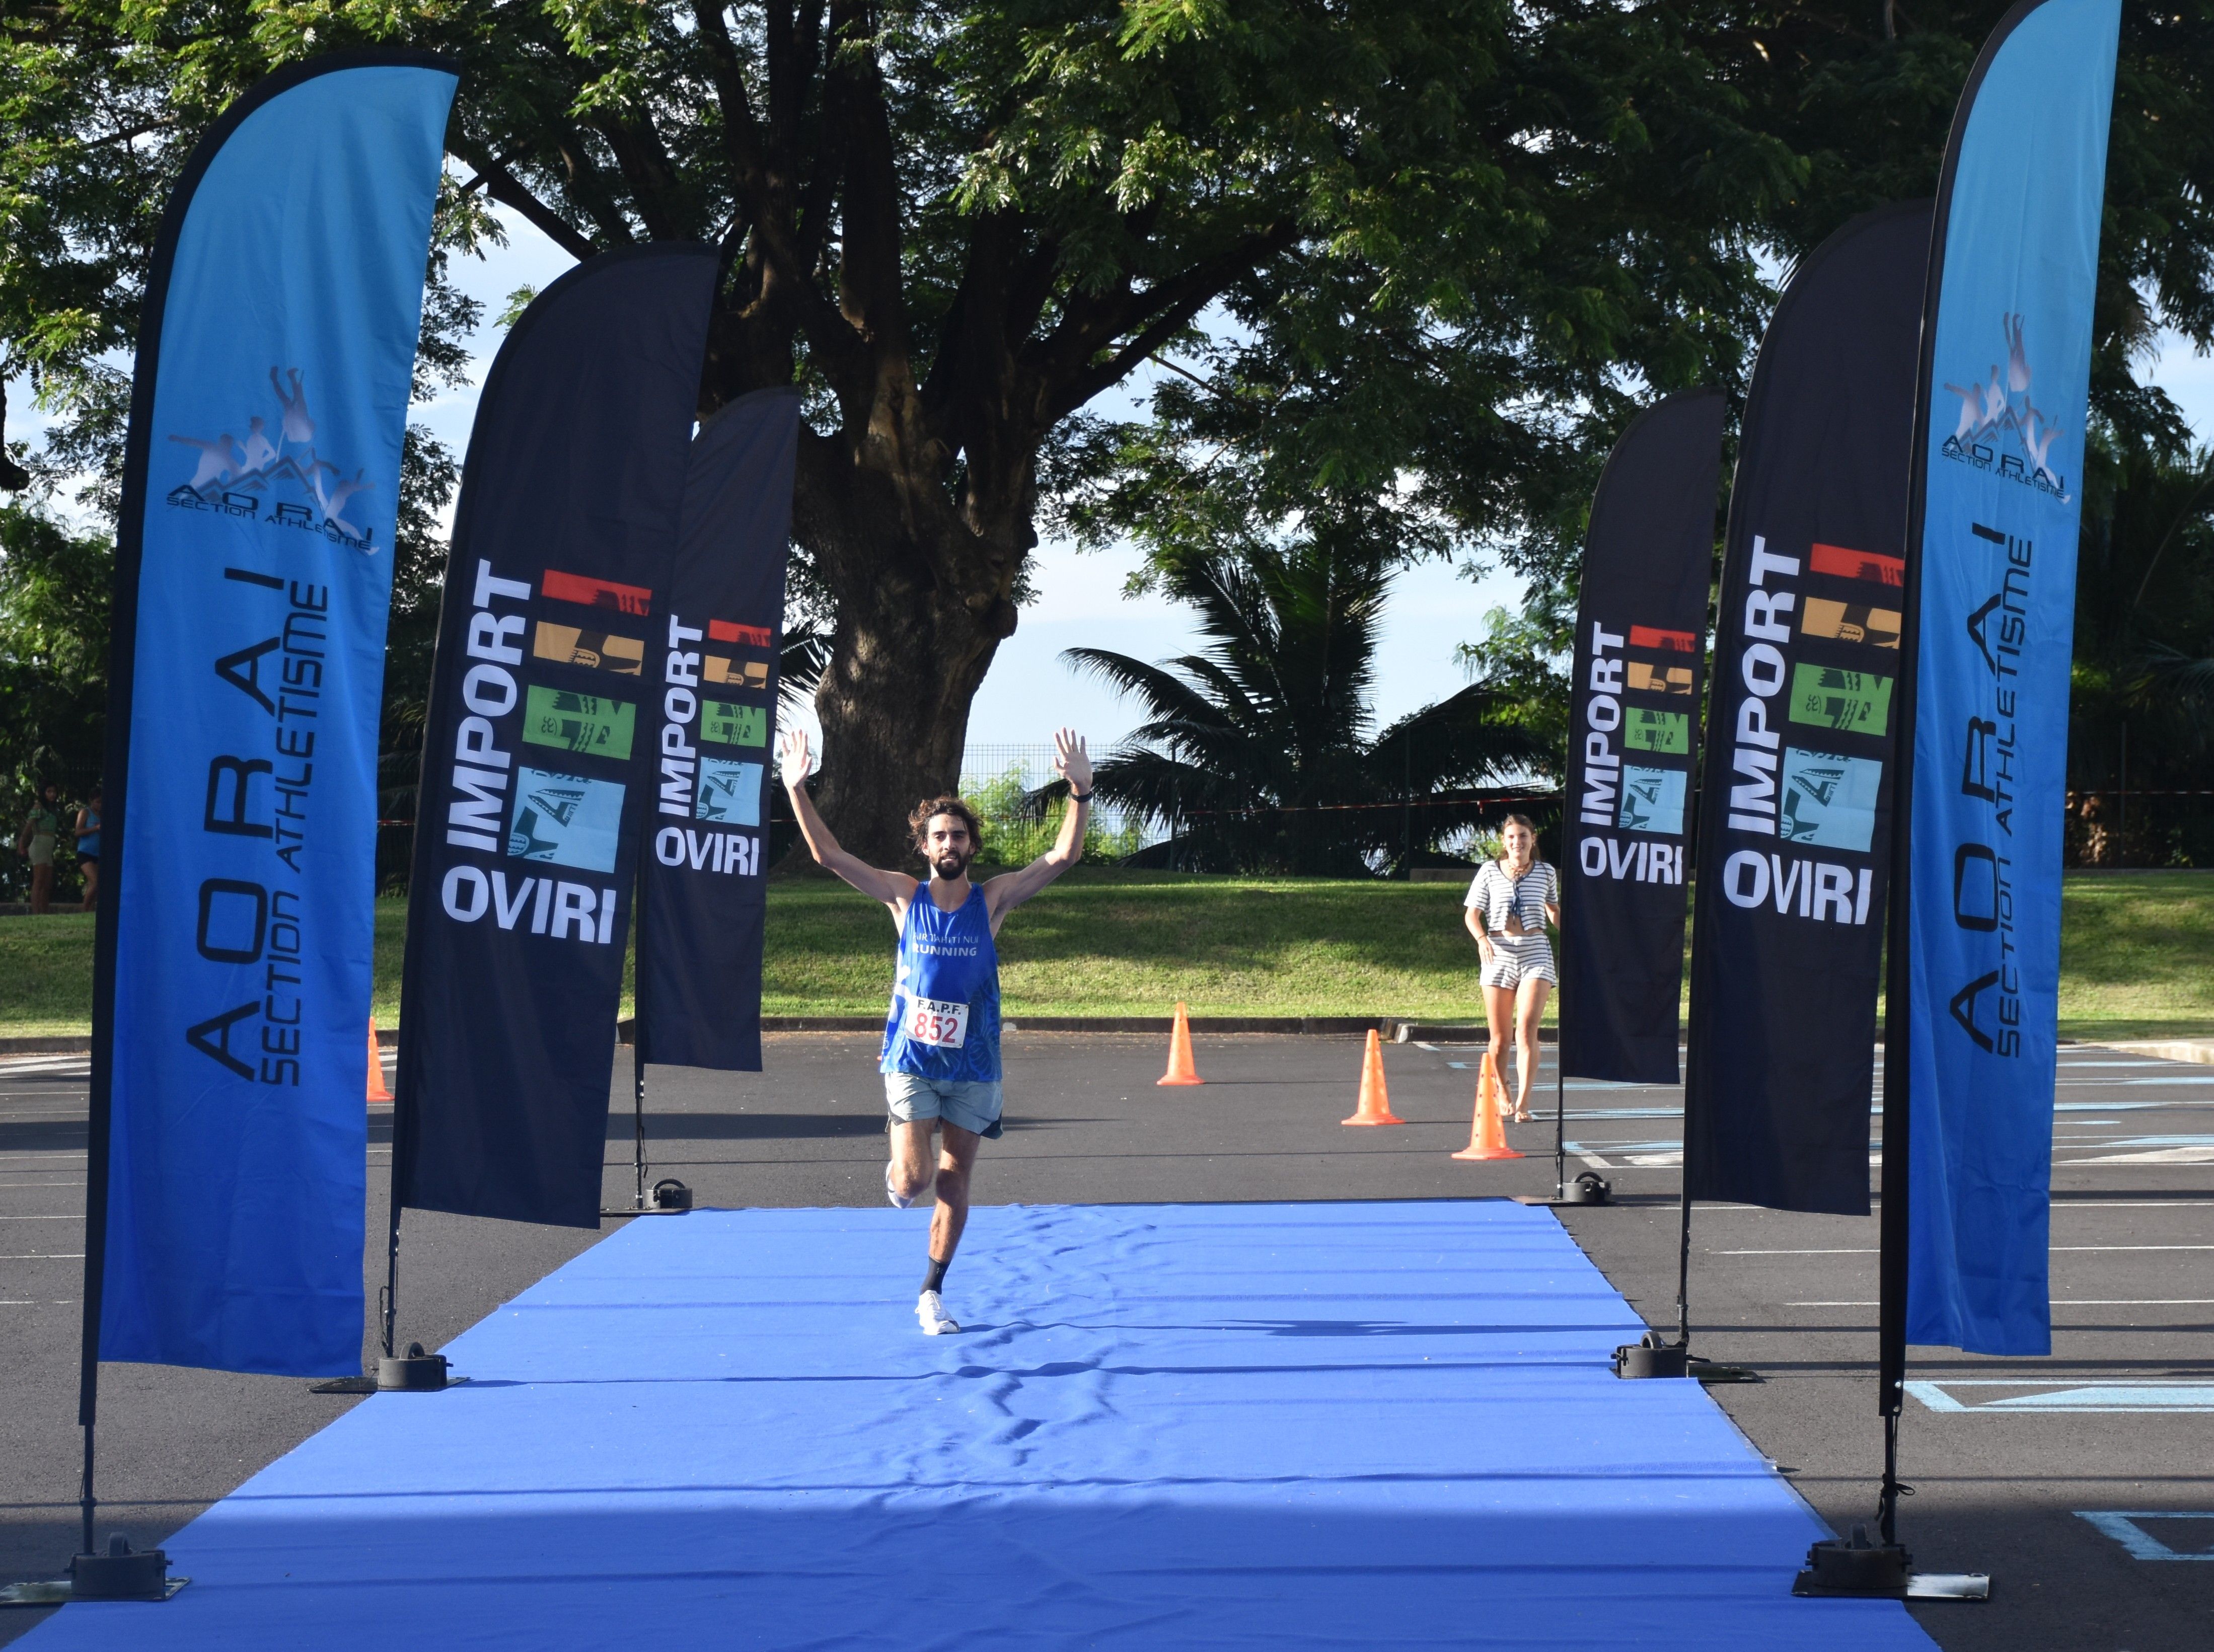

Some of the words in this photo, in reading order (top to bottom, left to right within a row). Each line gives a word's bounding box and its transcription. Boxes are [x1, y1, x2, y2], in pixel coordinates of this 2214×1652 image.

[1943, 435, 2063, 489] AORAI
[168, 484, 372, 541] AORAI
[447, 558, 531, 852] IMPORT
[659, 615, 702, 816] IMPORT
[1728, 535, 1800, 835] IMPORT
[1580, 622, 1624, 825] IMPORT
[1950, 522, 2006, 1054] AORAI
[186, 568, 284, 1082] AORAI
[656, 827, 759, 875] OVIRI
[1580, 837, 1683, 884] OVIRI
[1724, 850, 1872, 924] OVIRI
[442, 866, 616, 944] OVIRI
[912, 943, 977, 956] RUNNING
[964, 936, 978, 944] NUI
[914, 1013, 958, 1043] 852
[917, 999, 961, 1015] F.A.P.F.
